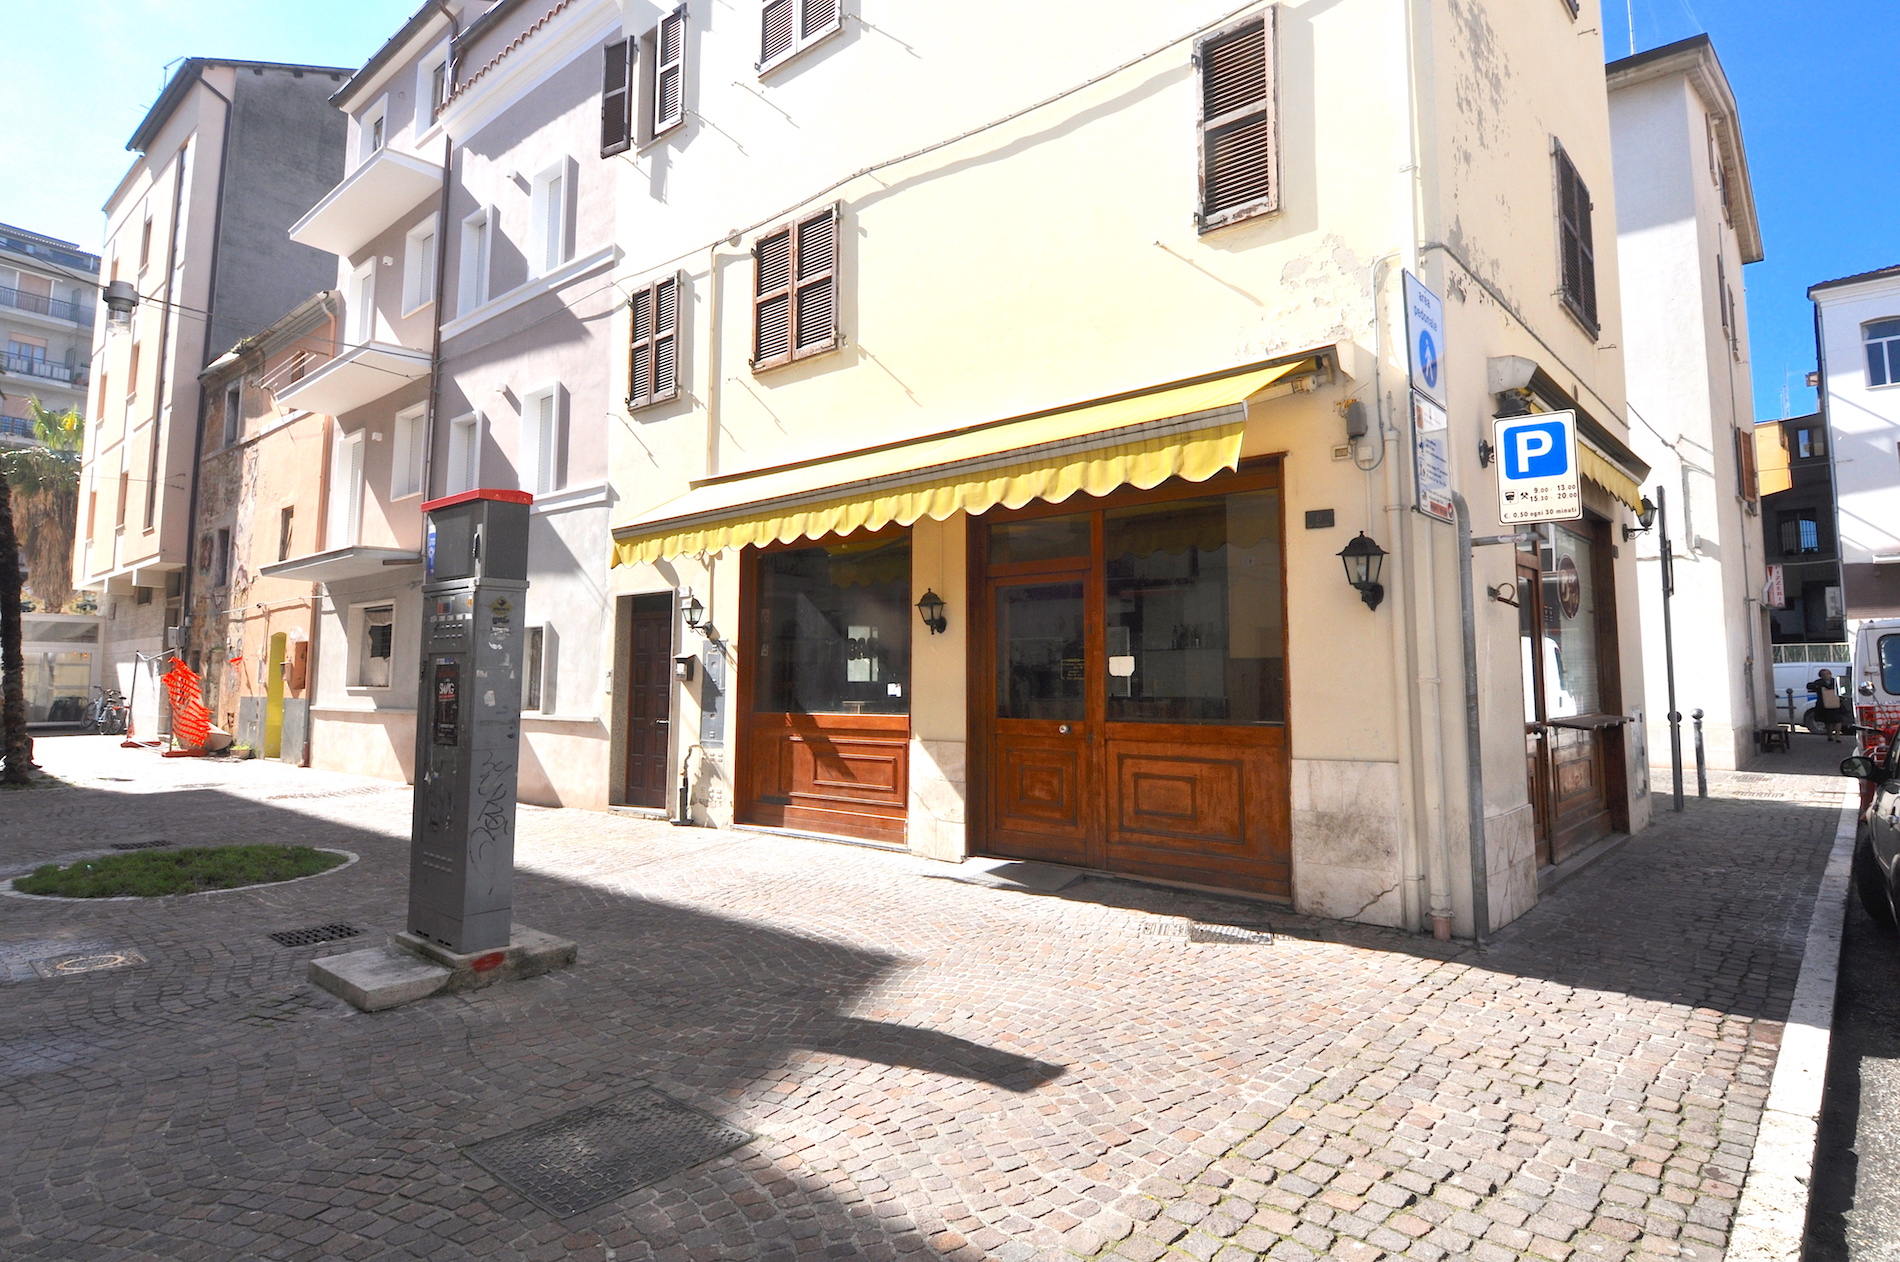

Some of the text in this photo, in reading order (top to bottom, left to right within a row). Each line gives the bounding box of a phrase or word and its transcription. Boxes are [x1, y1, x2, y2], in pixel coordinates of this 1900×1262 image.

[1418, 291, 1431, 309] area
[1413, 305, 1437, 331] pedonale
[1516, 430, 1553, 473] P
[1557, 492, 1578, 500] 20.00
[1555, 506, 1577, 514] minuti
[1775, 565, 1784, 607] PIZZERIA
